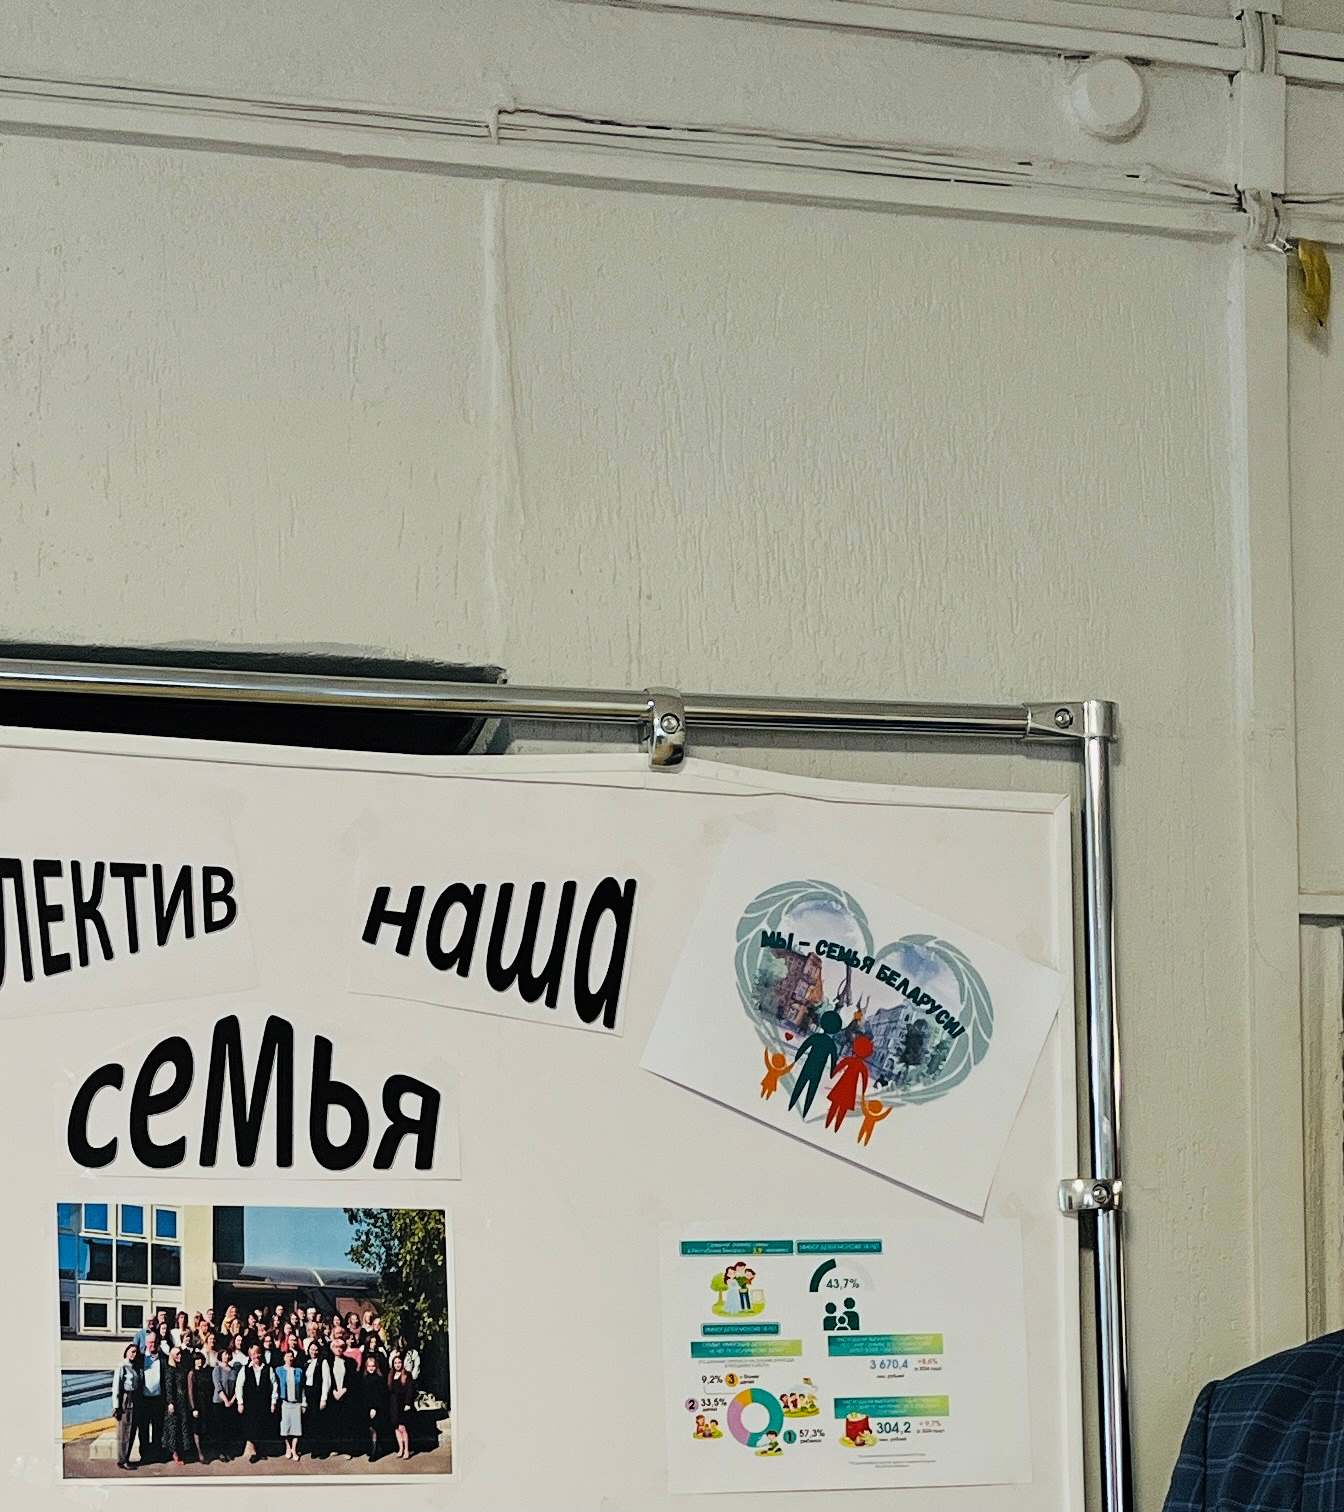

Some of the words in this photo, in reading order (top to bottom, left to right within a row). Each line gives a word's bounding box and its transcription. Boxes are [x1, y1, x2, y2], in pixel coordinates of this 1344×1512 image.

[361, 876, 638, 1029] наша
[760, 930, 794, 950] МЫ
[816, 939, 875, 974] СЕМЬЯ
[66, 1014, 441, 1171] семья
[826, 1278, 860, 1290] 43,7%
[876, 1421, 912, 1435] 304,2
